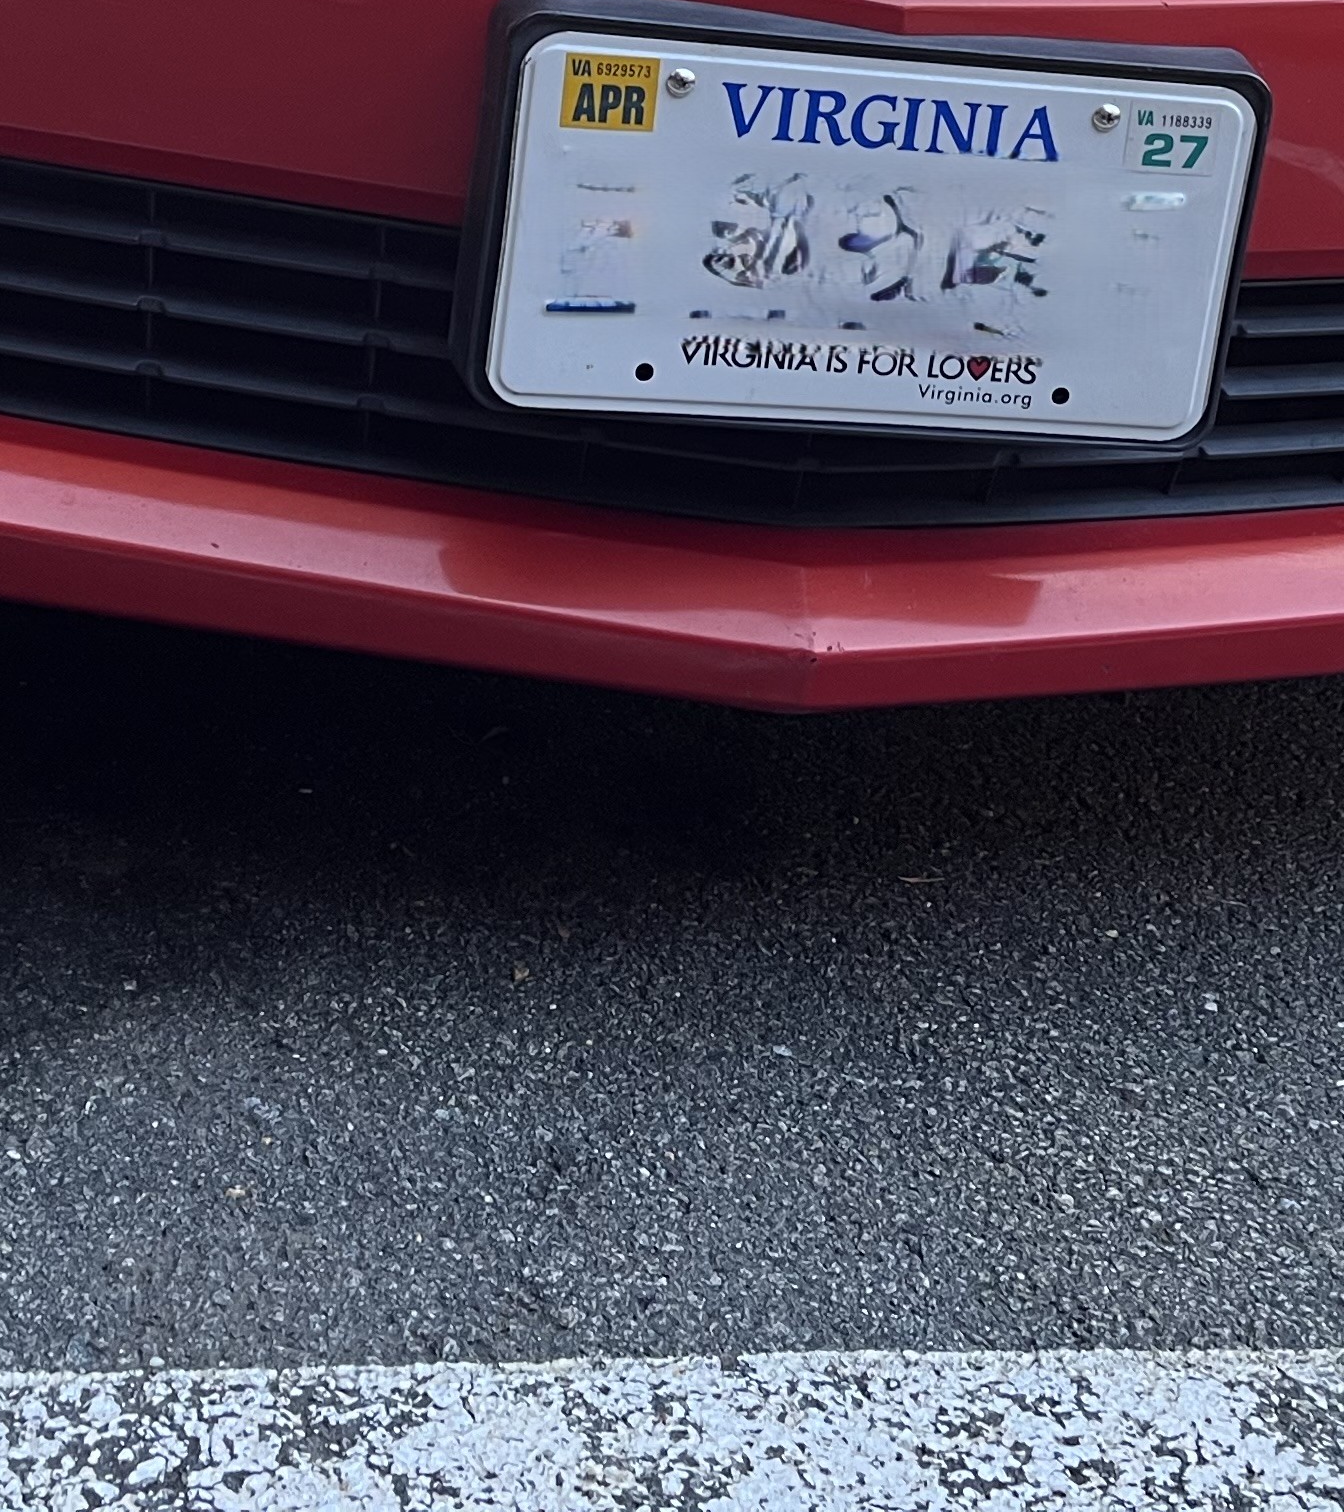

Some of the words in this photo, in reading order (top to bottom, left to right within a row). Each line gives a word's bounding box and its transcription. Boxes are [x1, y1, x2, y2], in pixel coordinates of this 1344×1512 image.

[571, 58, 592, 77] VA
[596, 62, 652, 79] 6929573
[571, 82, 646, 125] APR
[721, 81, 1059, 162] VIRGINIA
[1137, 109, 1154, 126] VA
[1161, 114, 1213, 130] 1188339
[1141, 132, 1209, 169] 27
[681, 335, 818, 373] VIRGINIA
[826, 343, 848, 374] IS
[857, 345, 918, 378] FOR
[918, 383, 1033, 410] Virginia.org
